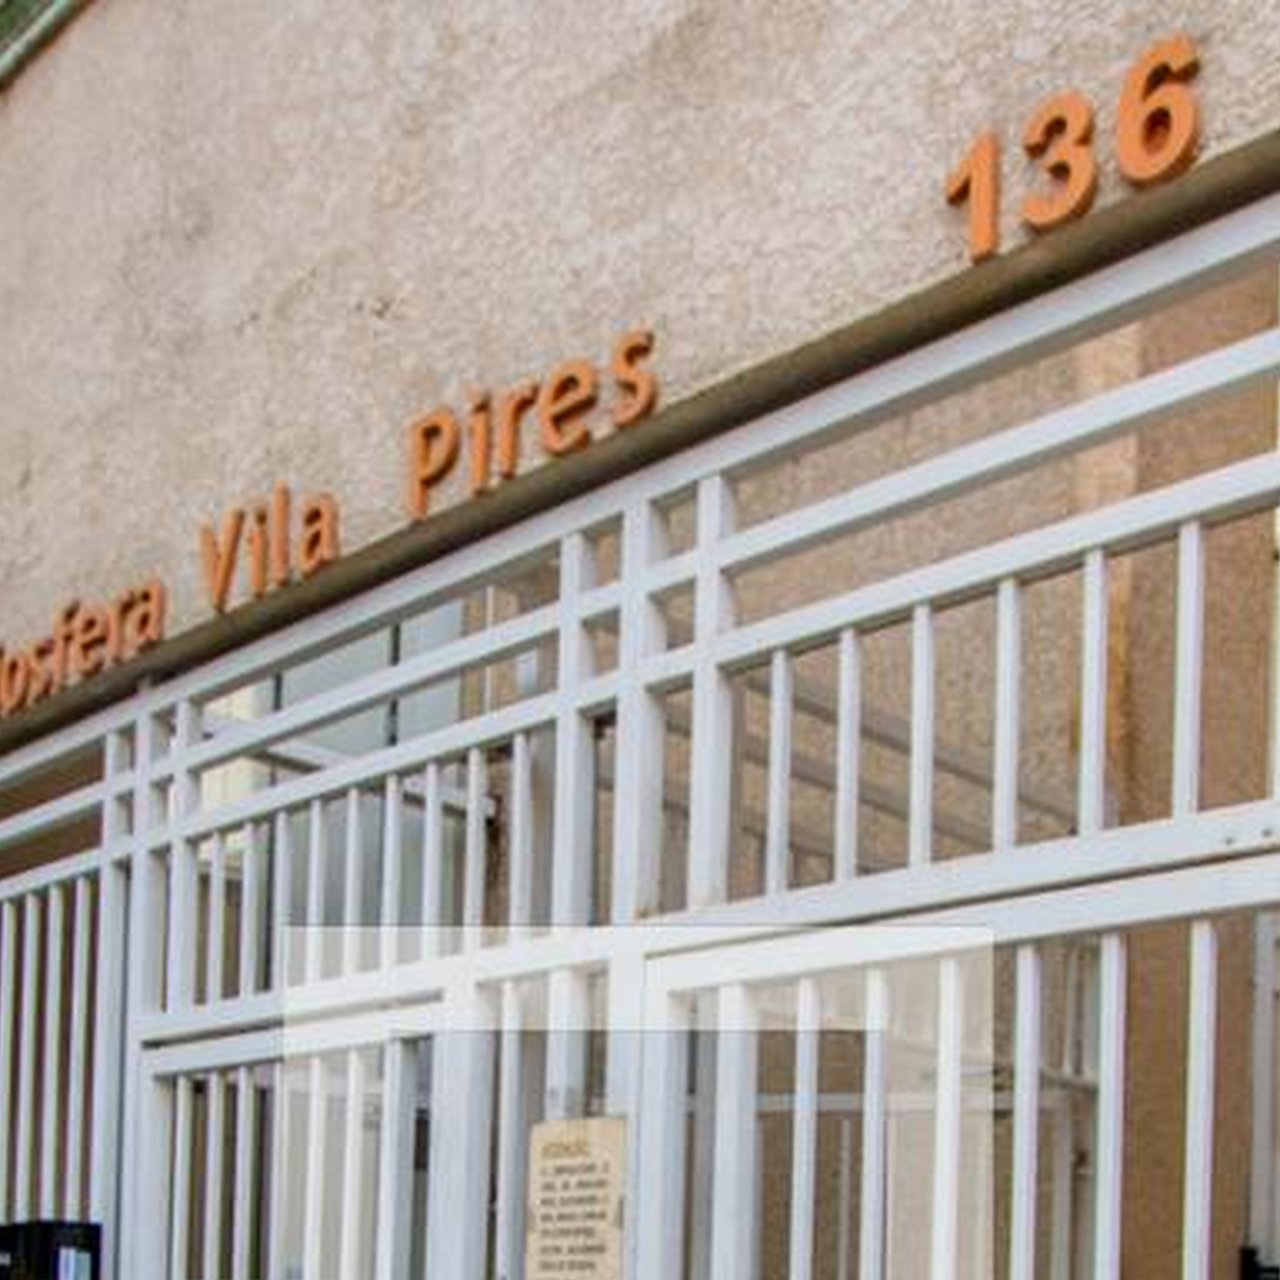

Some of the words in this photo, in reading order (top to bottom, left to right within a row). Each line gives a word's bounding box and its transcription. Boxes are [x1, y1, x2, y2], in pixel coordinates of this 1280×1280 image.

[946, 31, 1203, 265] 136
[197, 479, 342, 613] Vila
[405, 326, 662, 520] Pires
